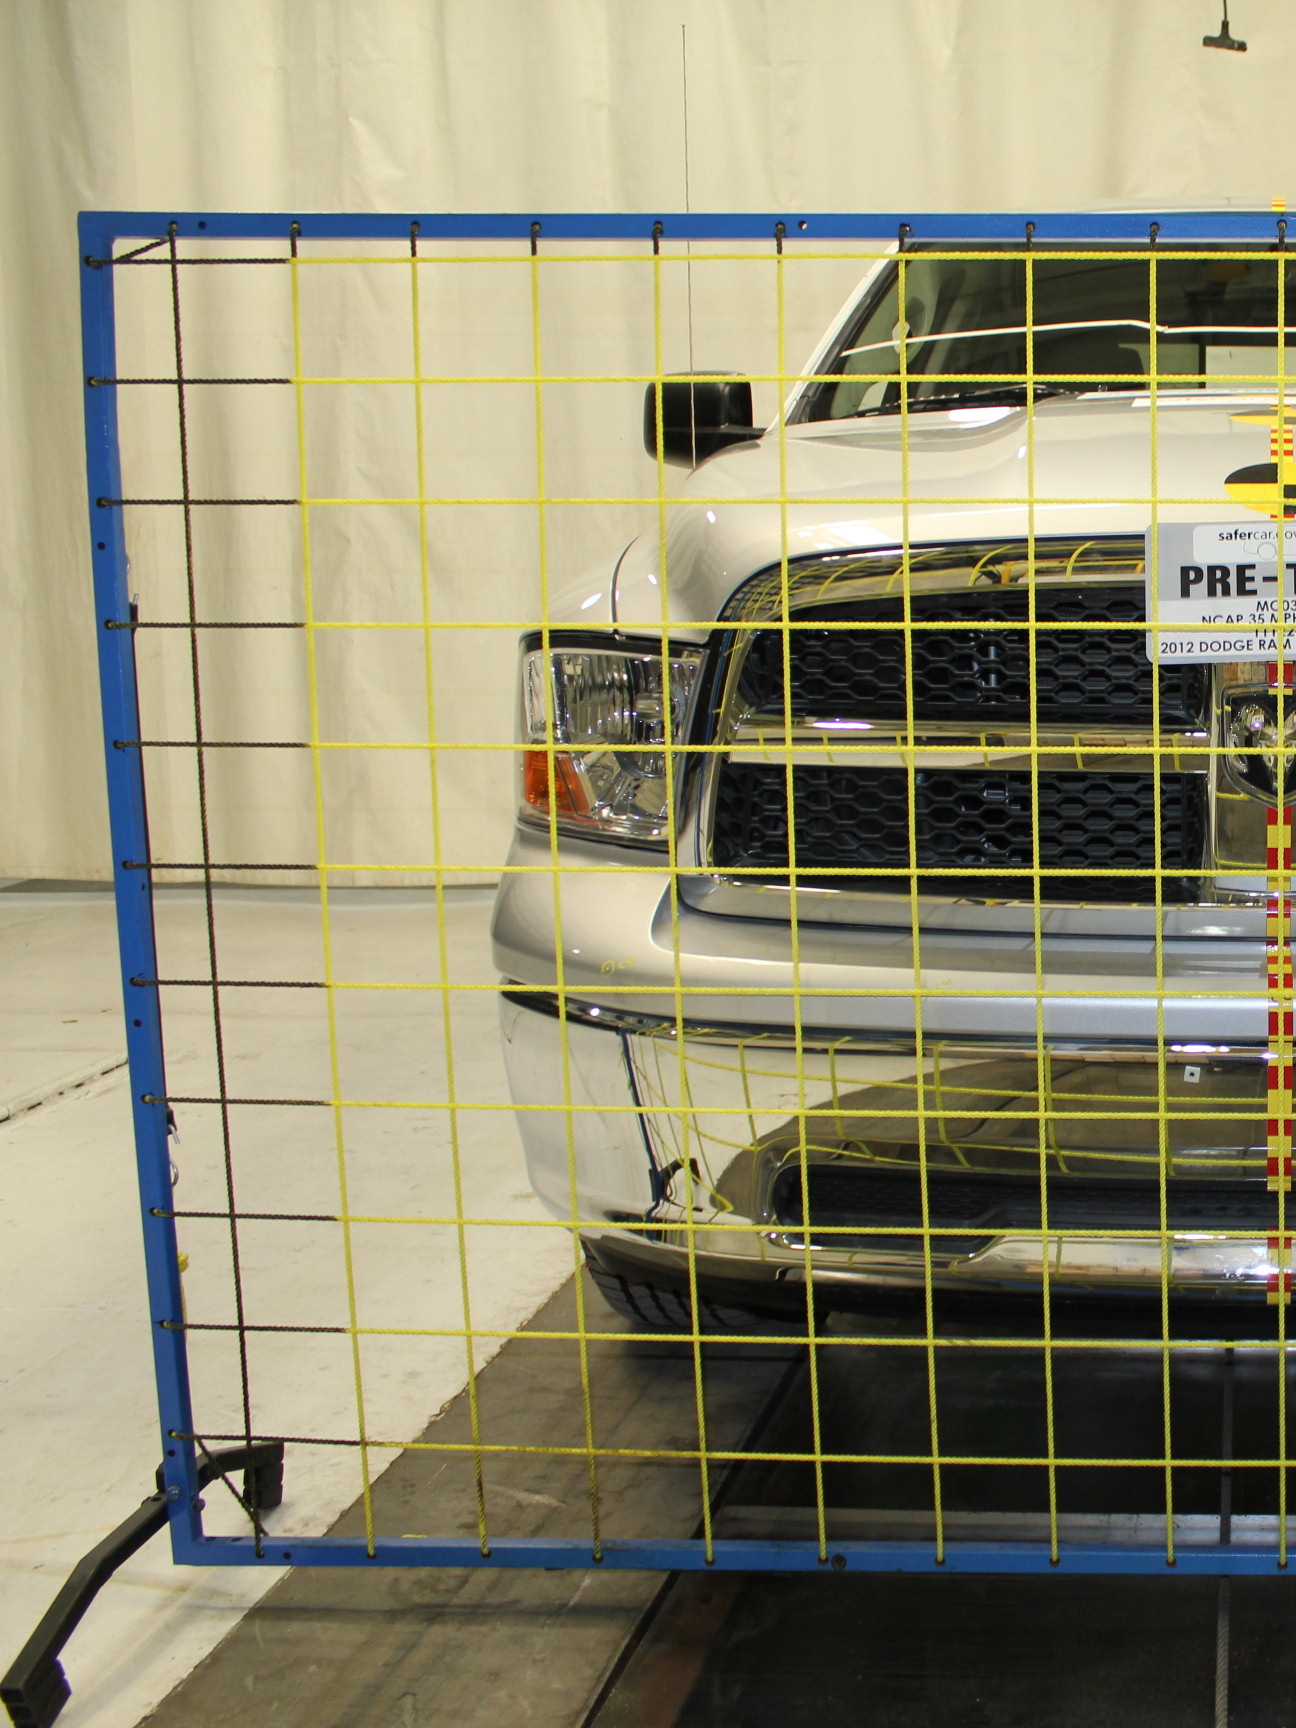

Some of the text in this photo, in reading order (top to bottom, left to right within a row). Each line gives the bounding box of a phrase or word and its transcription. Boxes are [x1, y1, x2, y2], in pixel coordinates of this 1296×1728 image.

[1202, 614, 1244, 626] NCAP
[1248, 613, 1265, 625] 35
[1160, 641, 1194, 654] 2012
[1199, 639, 1254, 653] DODGE
[1258, 637, 1292, 651] RAM
